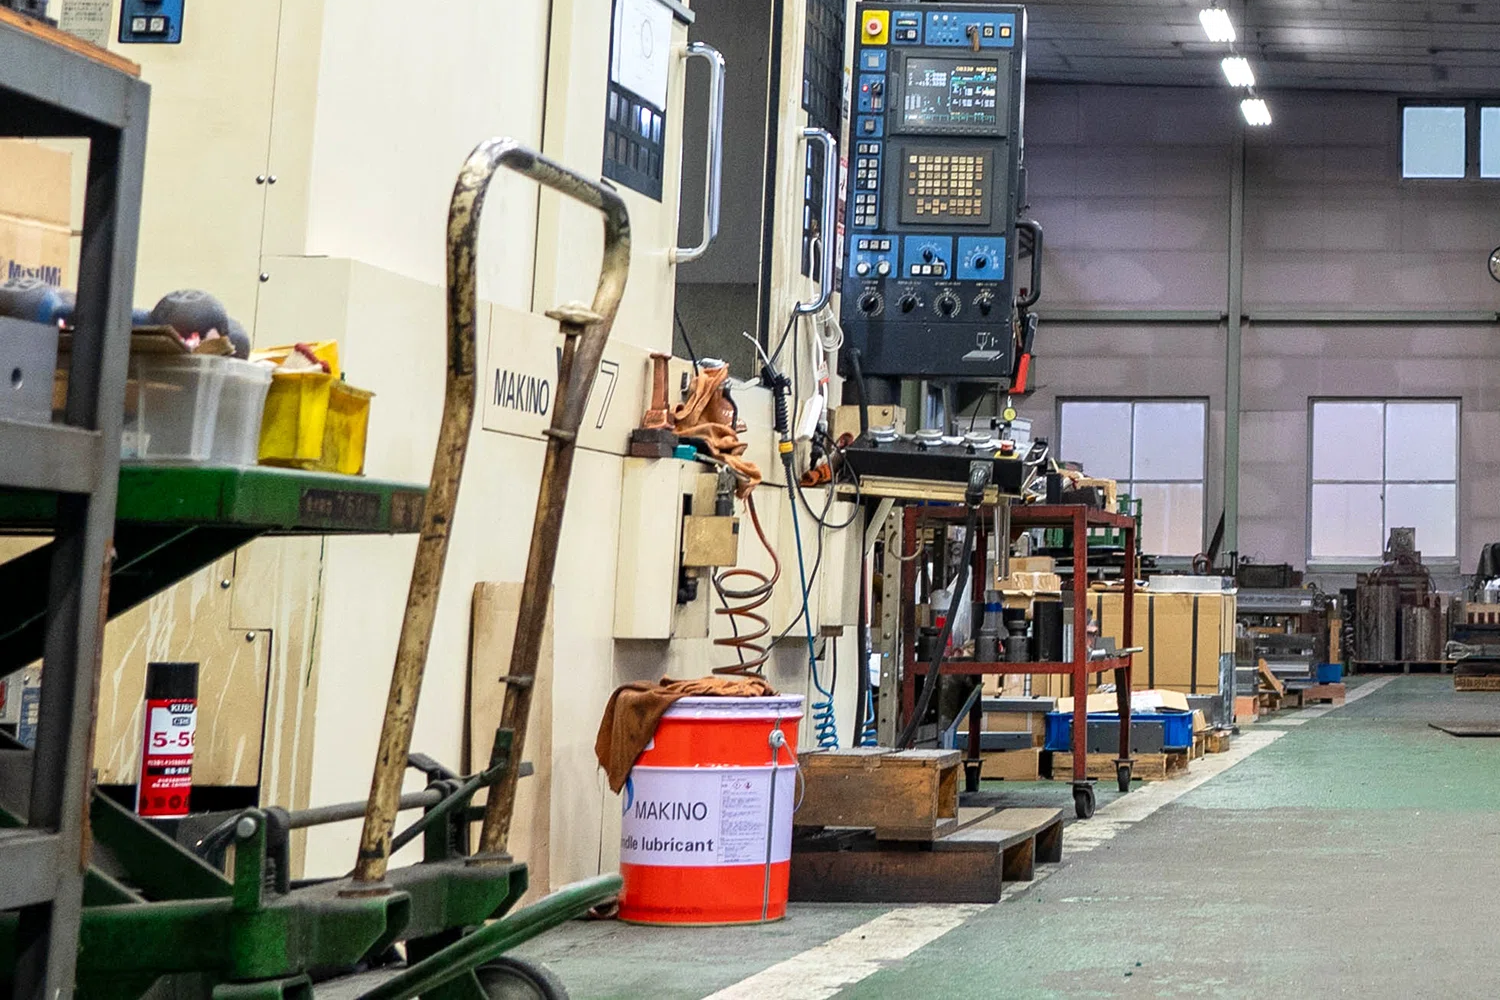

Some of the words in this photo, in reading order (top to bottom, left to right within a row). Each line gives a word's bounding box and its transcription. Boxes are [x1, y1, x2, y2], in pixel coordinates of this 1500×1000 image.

[493, 368, 550, 416] MAKINO
[635, 801, 708, 821] MAKINO
[641, 836, 714, 852] lubricant
